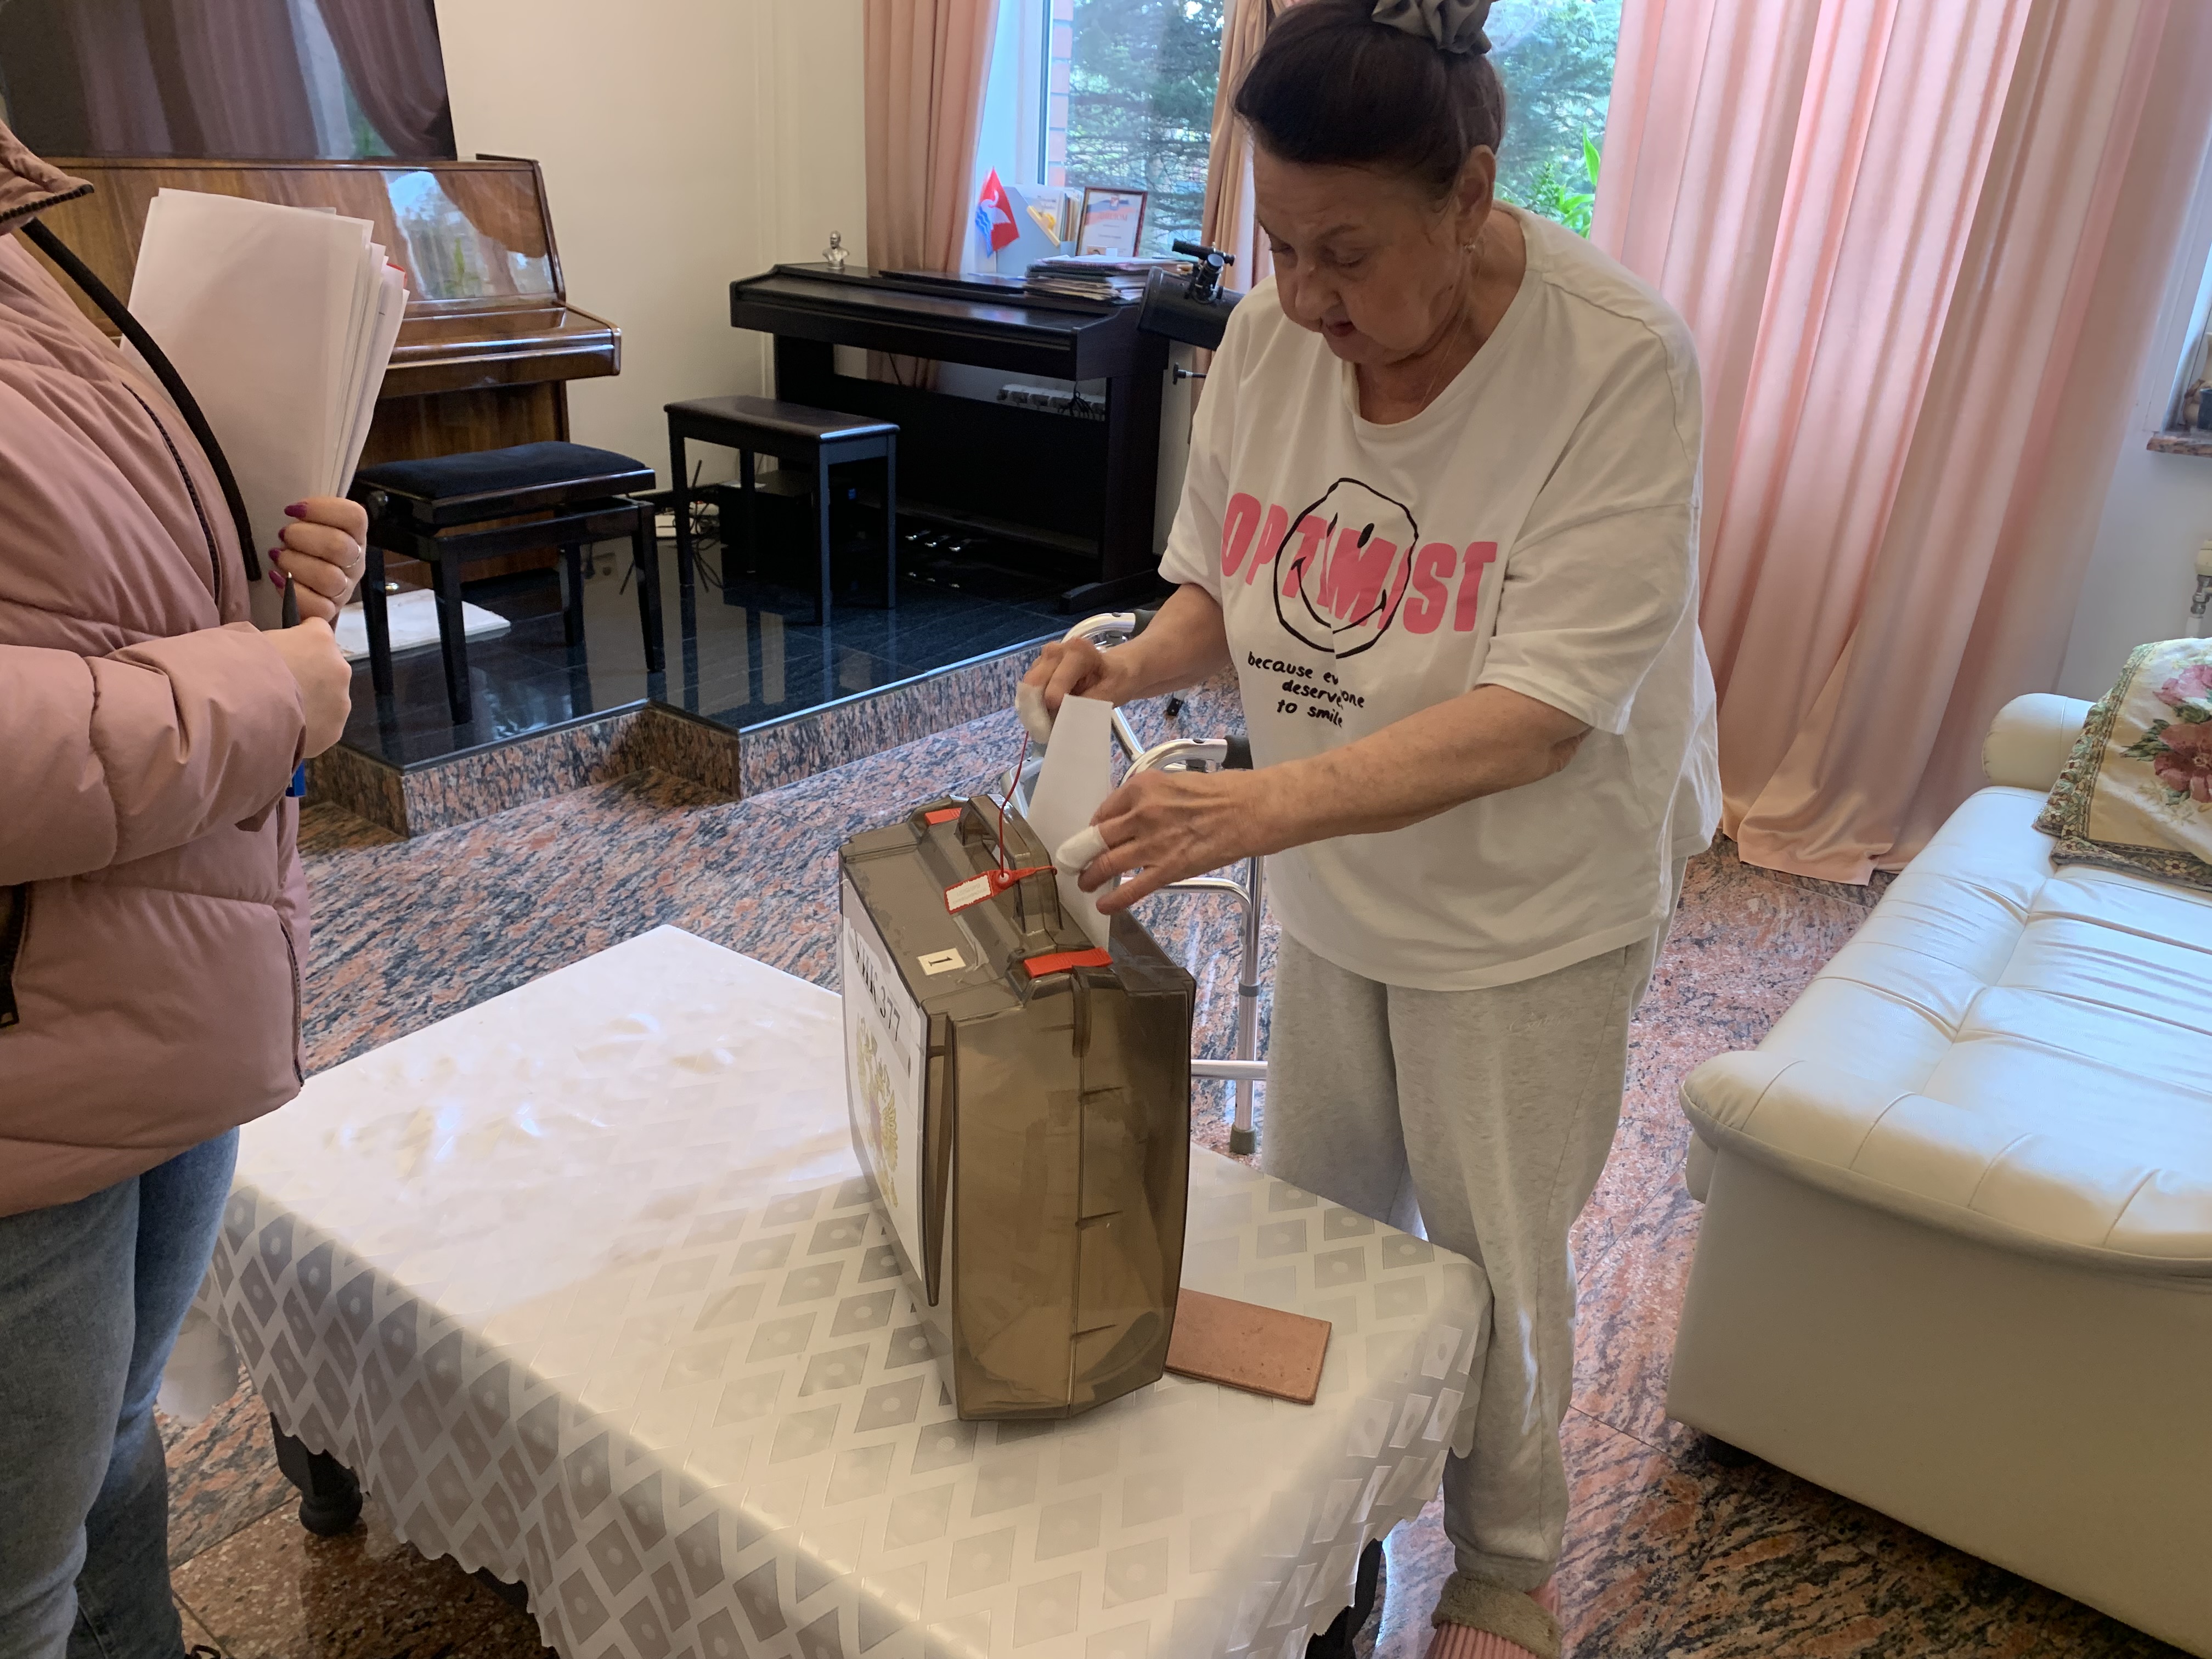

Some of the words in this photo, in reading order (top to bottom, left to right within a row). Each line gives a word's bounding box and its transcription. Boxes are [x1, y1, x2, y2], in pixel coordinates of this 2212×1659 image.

[1248, 651, 1313, 679] because
[1277, 699, 1298, 714] to
[1307, 706, 1343, 729] smile
[928, 956, 953, 967] 1
[880, 985, 901, 1042] 377
